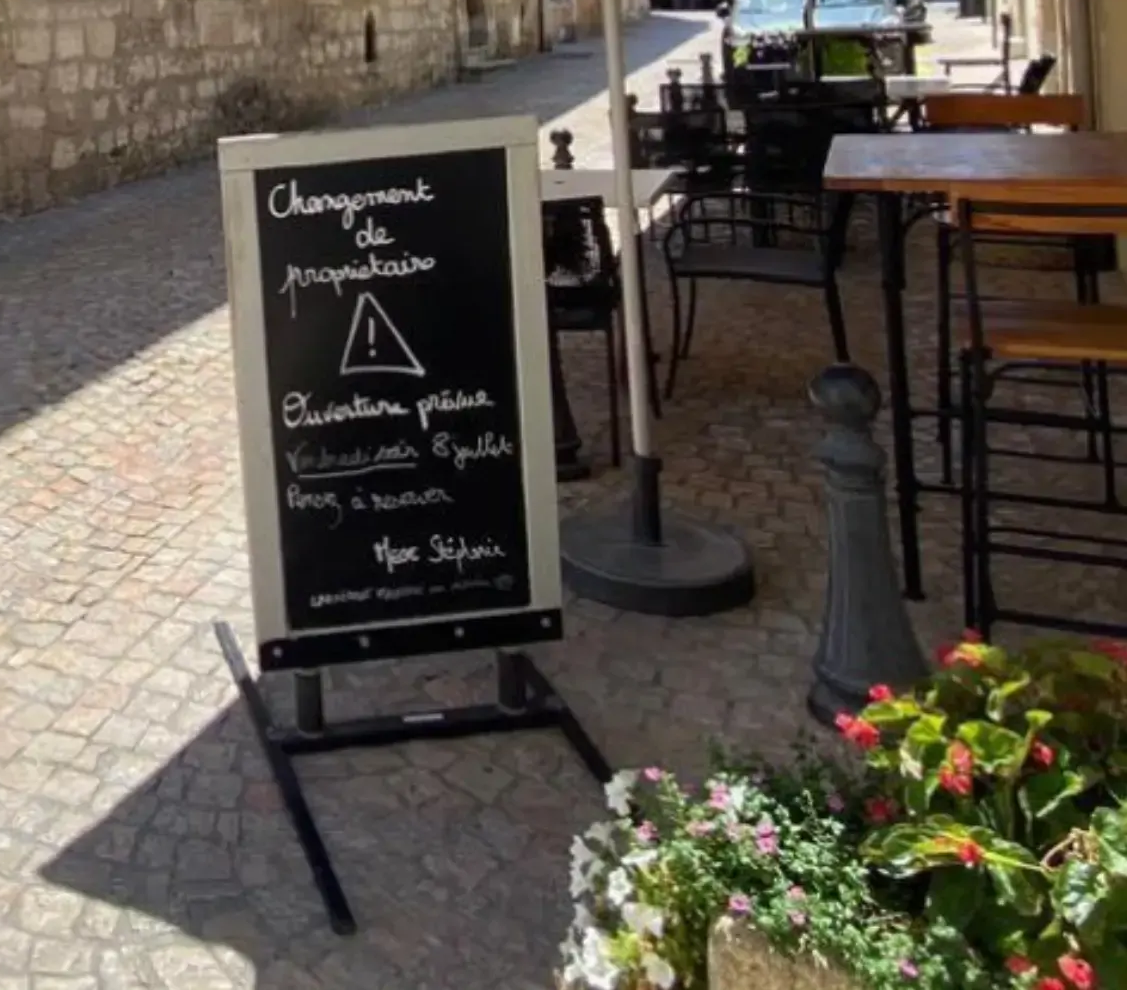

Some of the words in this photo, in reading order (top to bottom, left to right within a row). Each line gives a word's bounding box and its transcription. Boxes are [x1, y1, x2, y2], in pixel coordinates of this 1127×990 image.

[355, 216, 396, 249] de
[281, 391, 409, 428] Ouverture
[431, 431, 451, 457] 8
